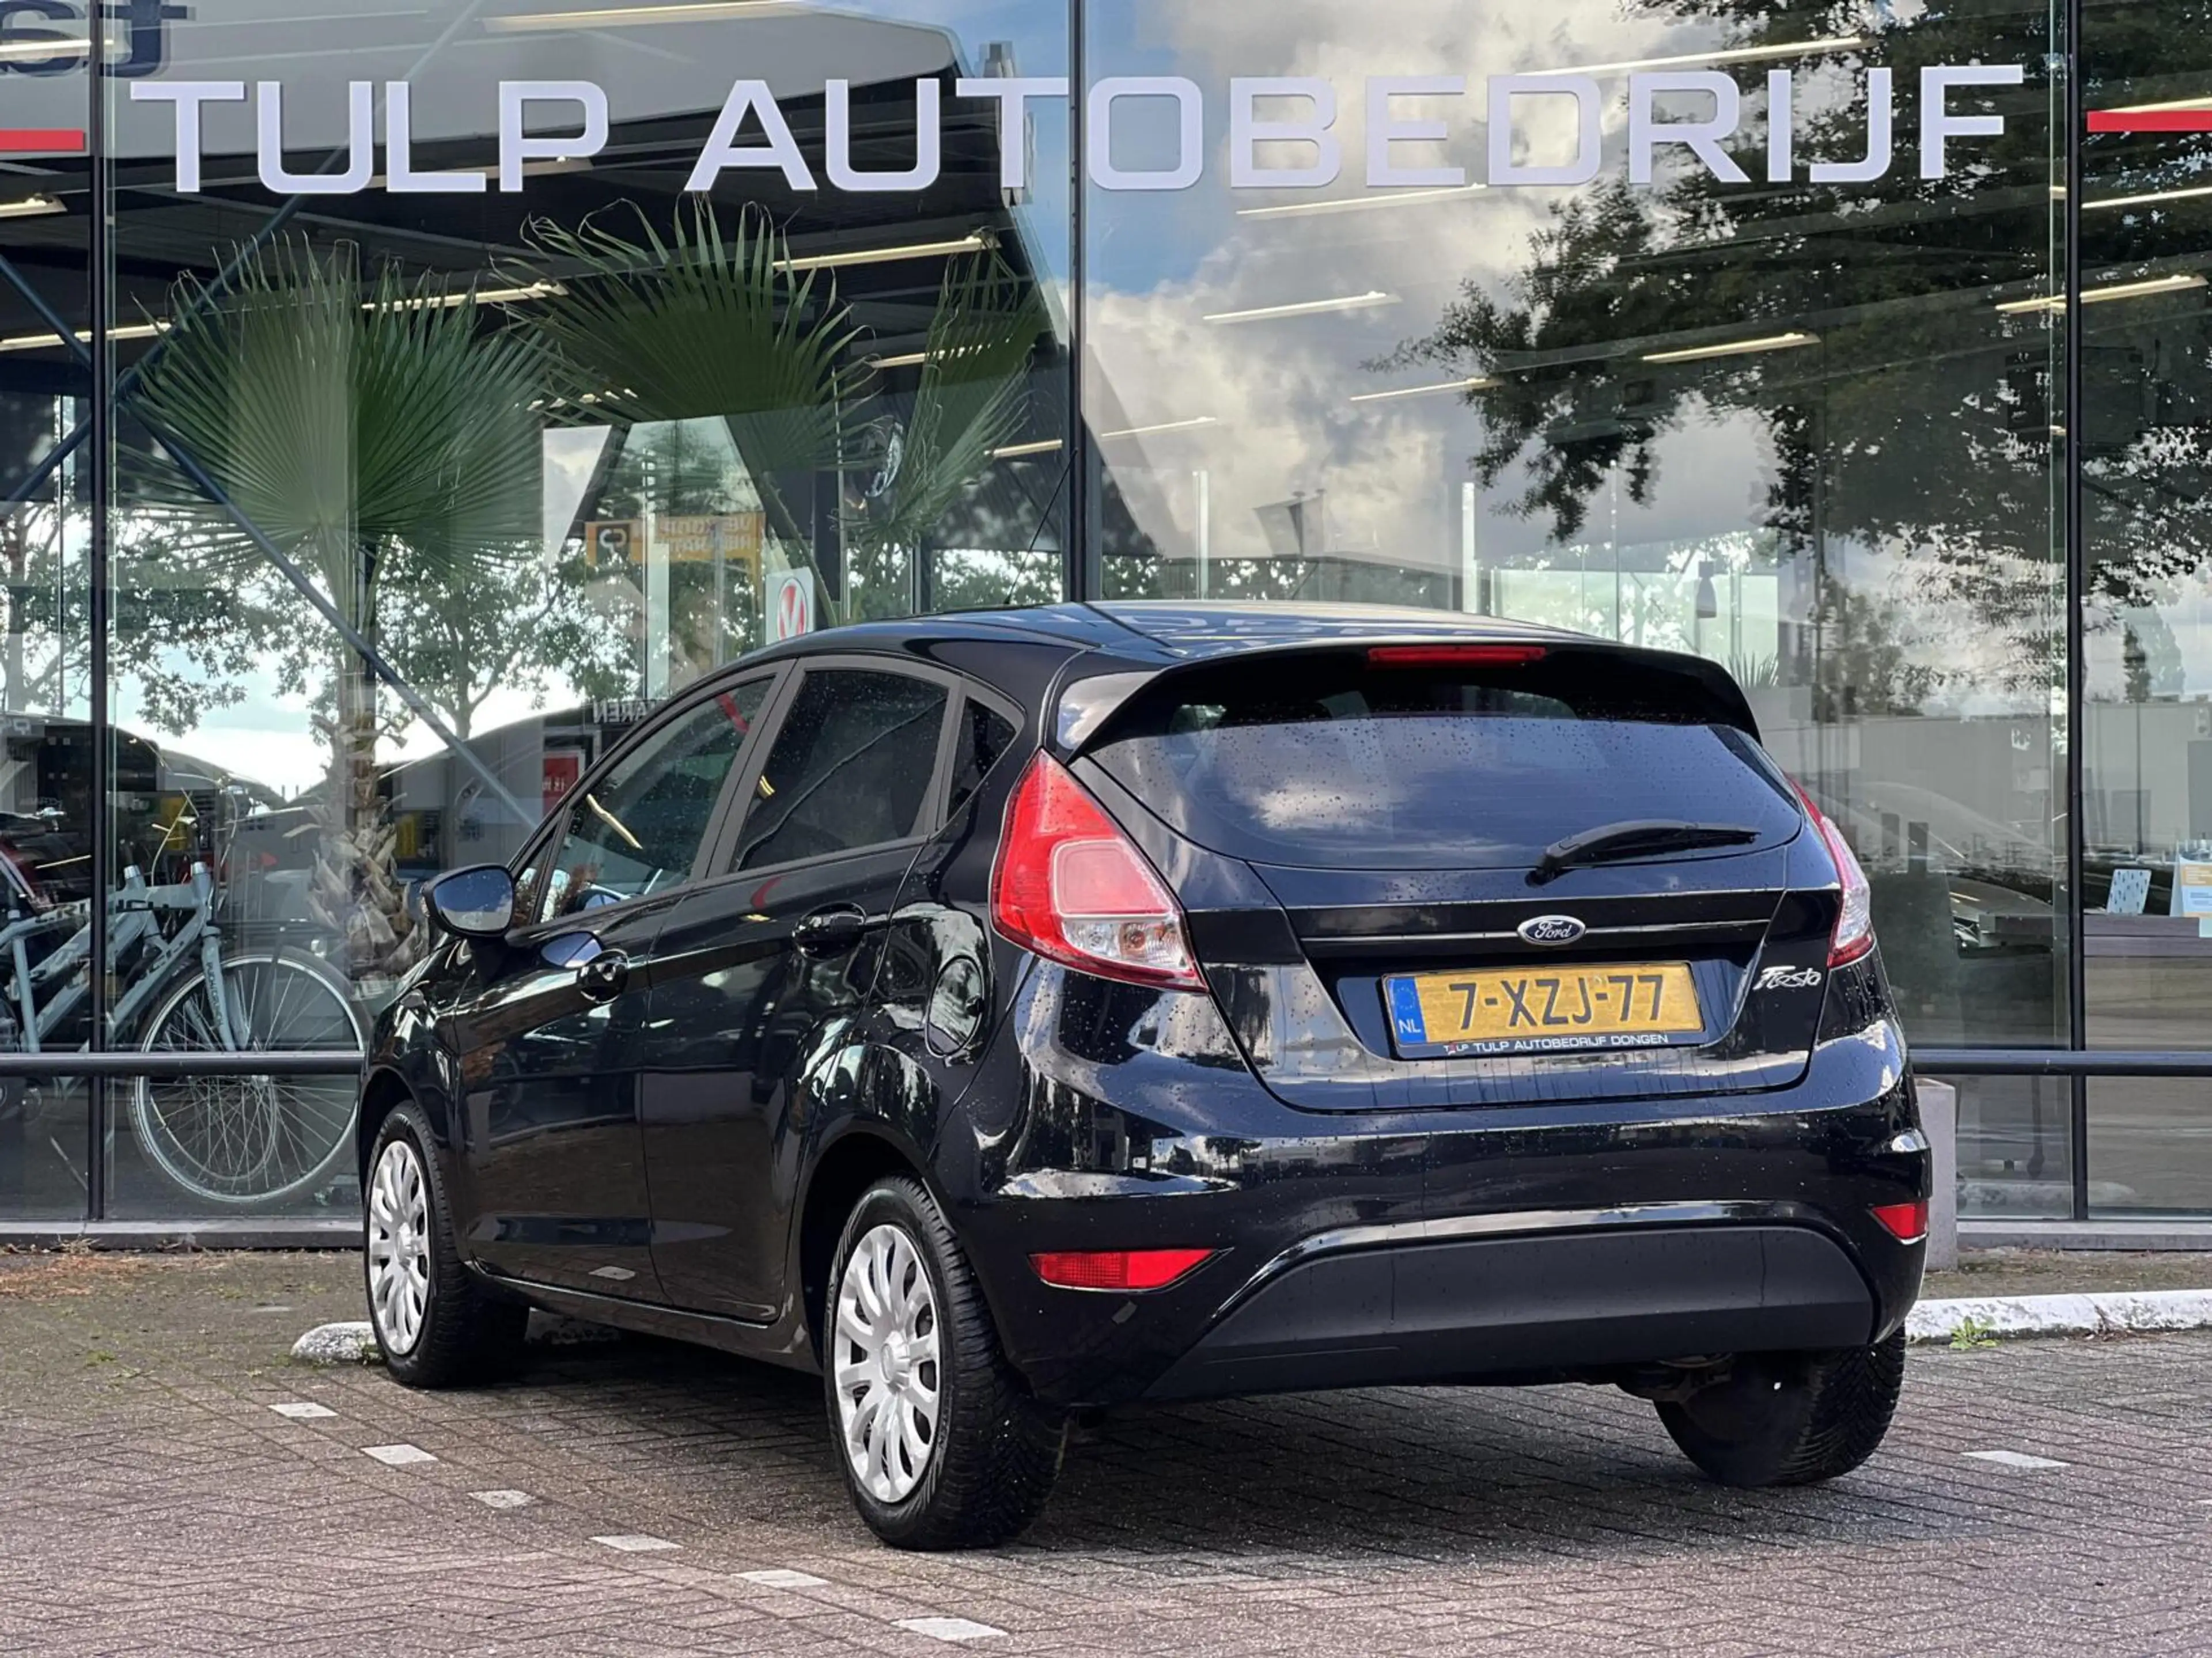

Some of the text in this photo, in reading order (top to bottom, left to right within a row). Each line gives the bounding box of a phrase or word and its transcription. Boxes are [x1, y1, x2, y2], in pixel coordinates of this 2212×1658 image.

[130, 64, 2023, 194] TULP AUTOBEDRIJF
[1534, 920, 1573, 939] Ford
[1753, 965, 1821, 990] Fiesta
[1449, 975, 1663, 1030] 7-XZJ-77
[1398, 1018, 1421, 1034] NL
[1473, 1041, 1510, 1053] TULP
[1514, 1036, 1607, 1050] AUTOBEDRIJF
[1611, 1034, 1669, 1046] DONGEN
